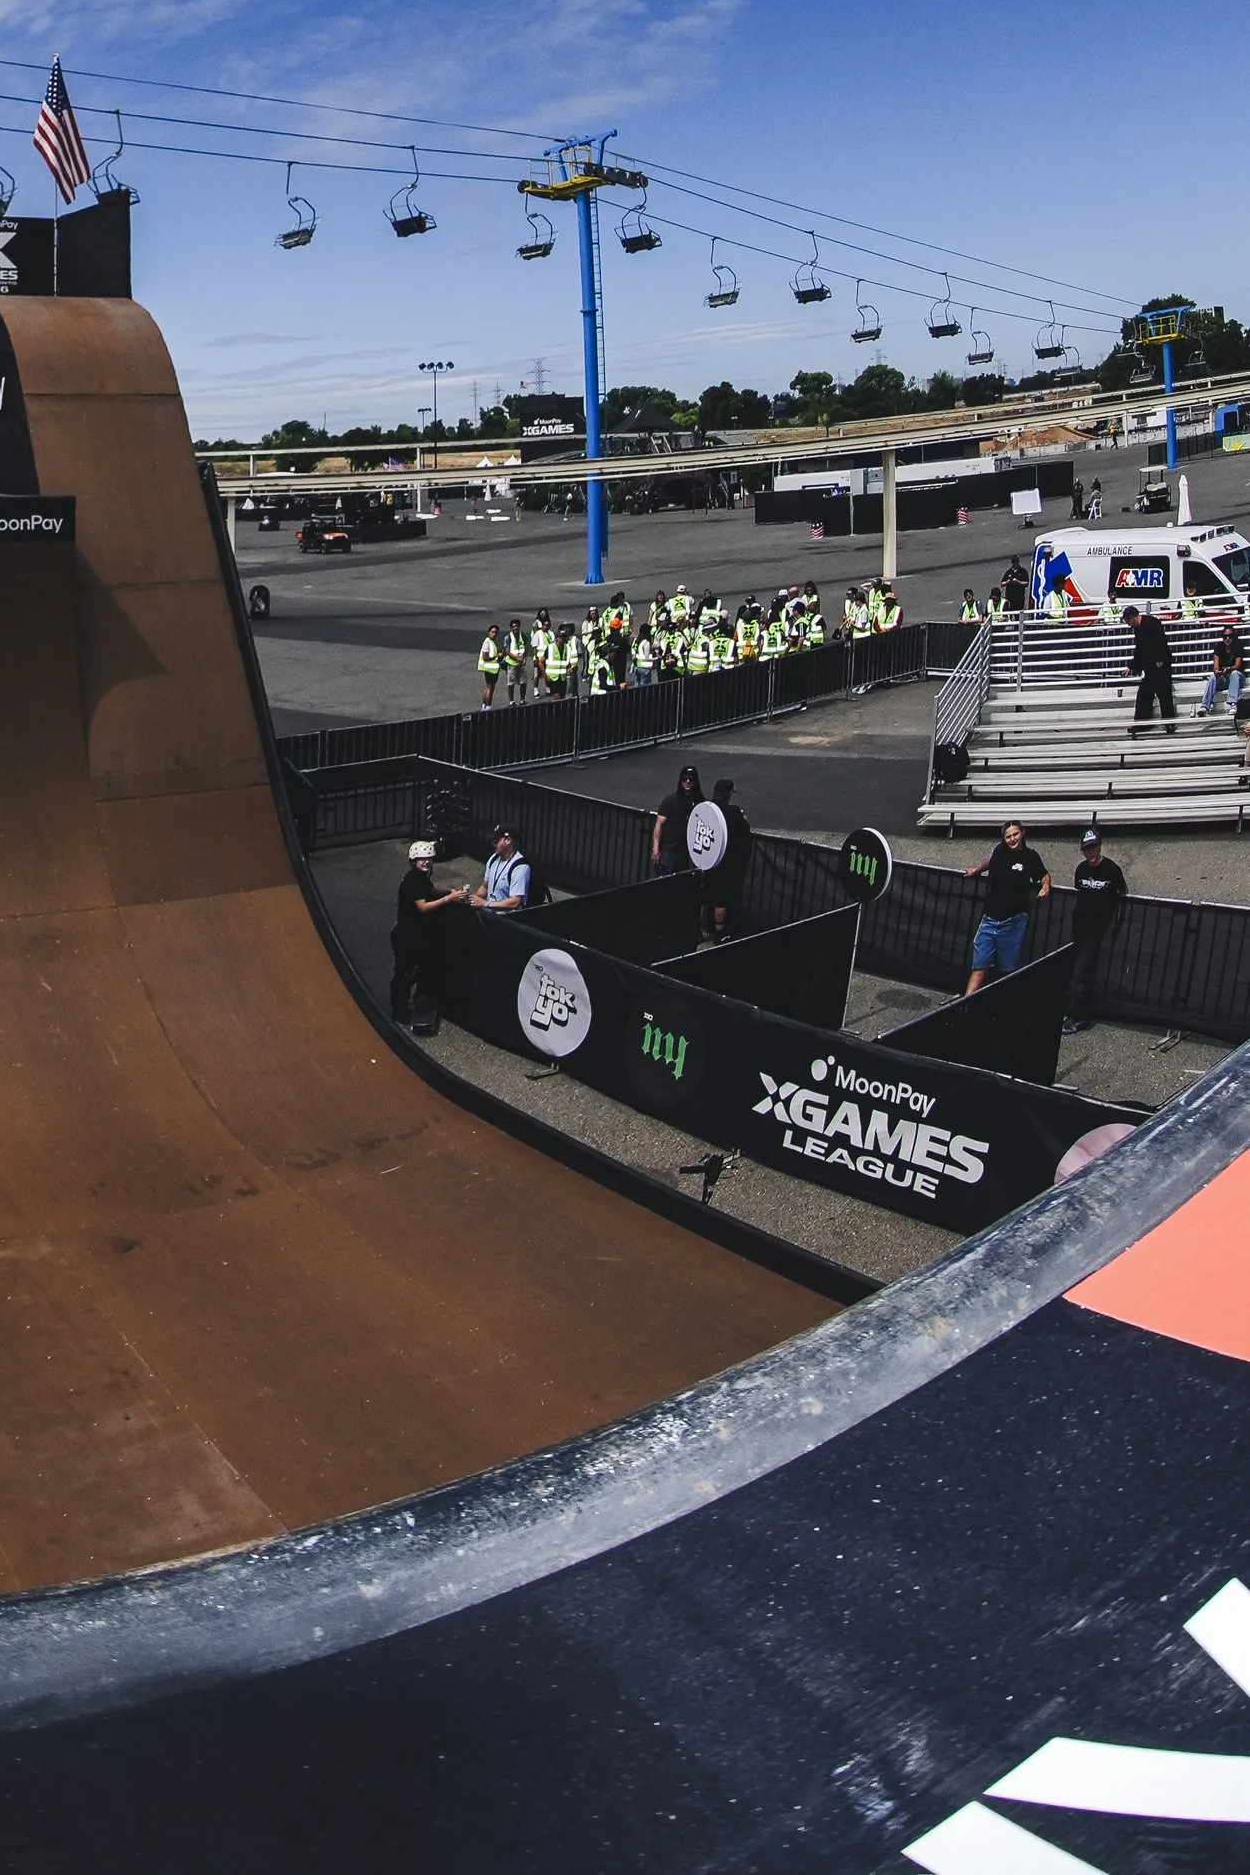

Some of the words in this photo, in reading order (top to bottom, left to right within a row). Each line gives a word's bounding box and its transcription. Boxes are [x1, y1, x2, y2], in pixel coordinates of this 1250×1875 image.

[522, 423, 575, 436] XGAMES
[1086, 545, 1133, 556] AMBULANCE
[1115, 567, 1164, 588] AMR
[834, 1065, 936, 1118] MoonPay
[751, 1071, 990, 1184] XGAMES
[782, 1129, 939, 1199] LEAGUE
